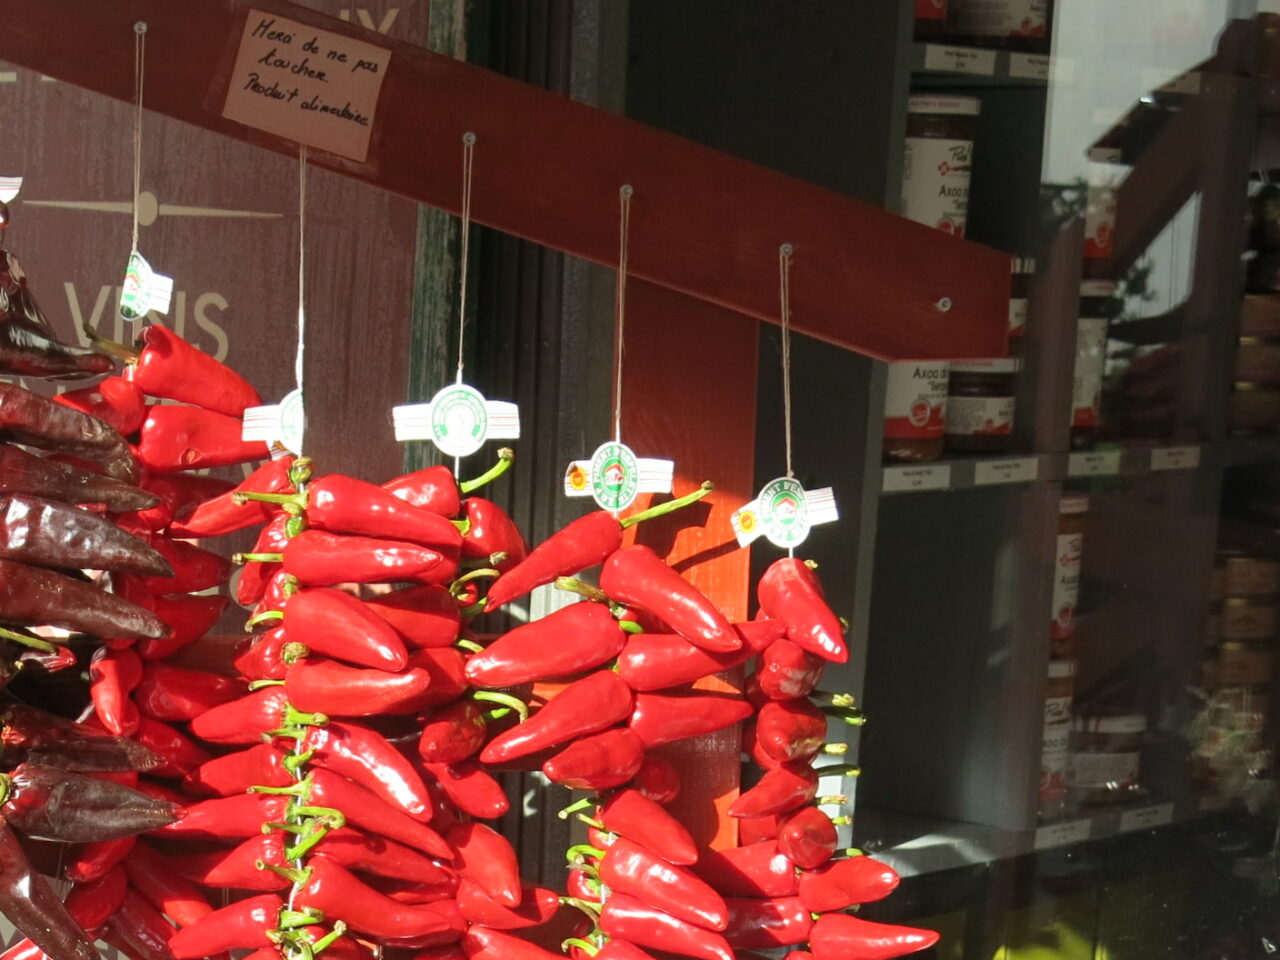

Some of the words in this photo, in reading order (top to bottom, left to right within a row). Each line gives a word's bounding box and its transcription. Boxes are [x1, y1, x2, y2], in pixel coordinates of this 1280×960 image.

[302, 36, 320, 54] de
[326, 49, 348, 63] ne
[351, 58, 379, 73] pas
[244, 72, 299, 103] Produit
[300, 95, 369, 126] alimentaire
